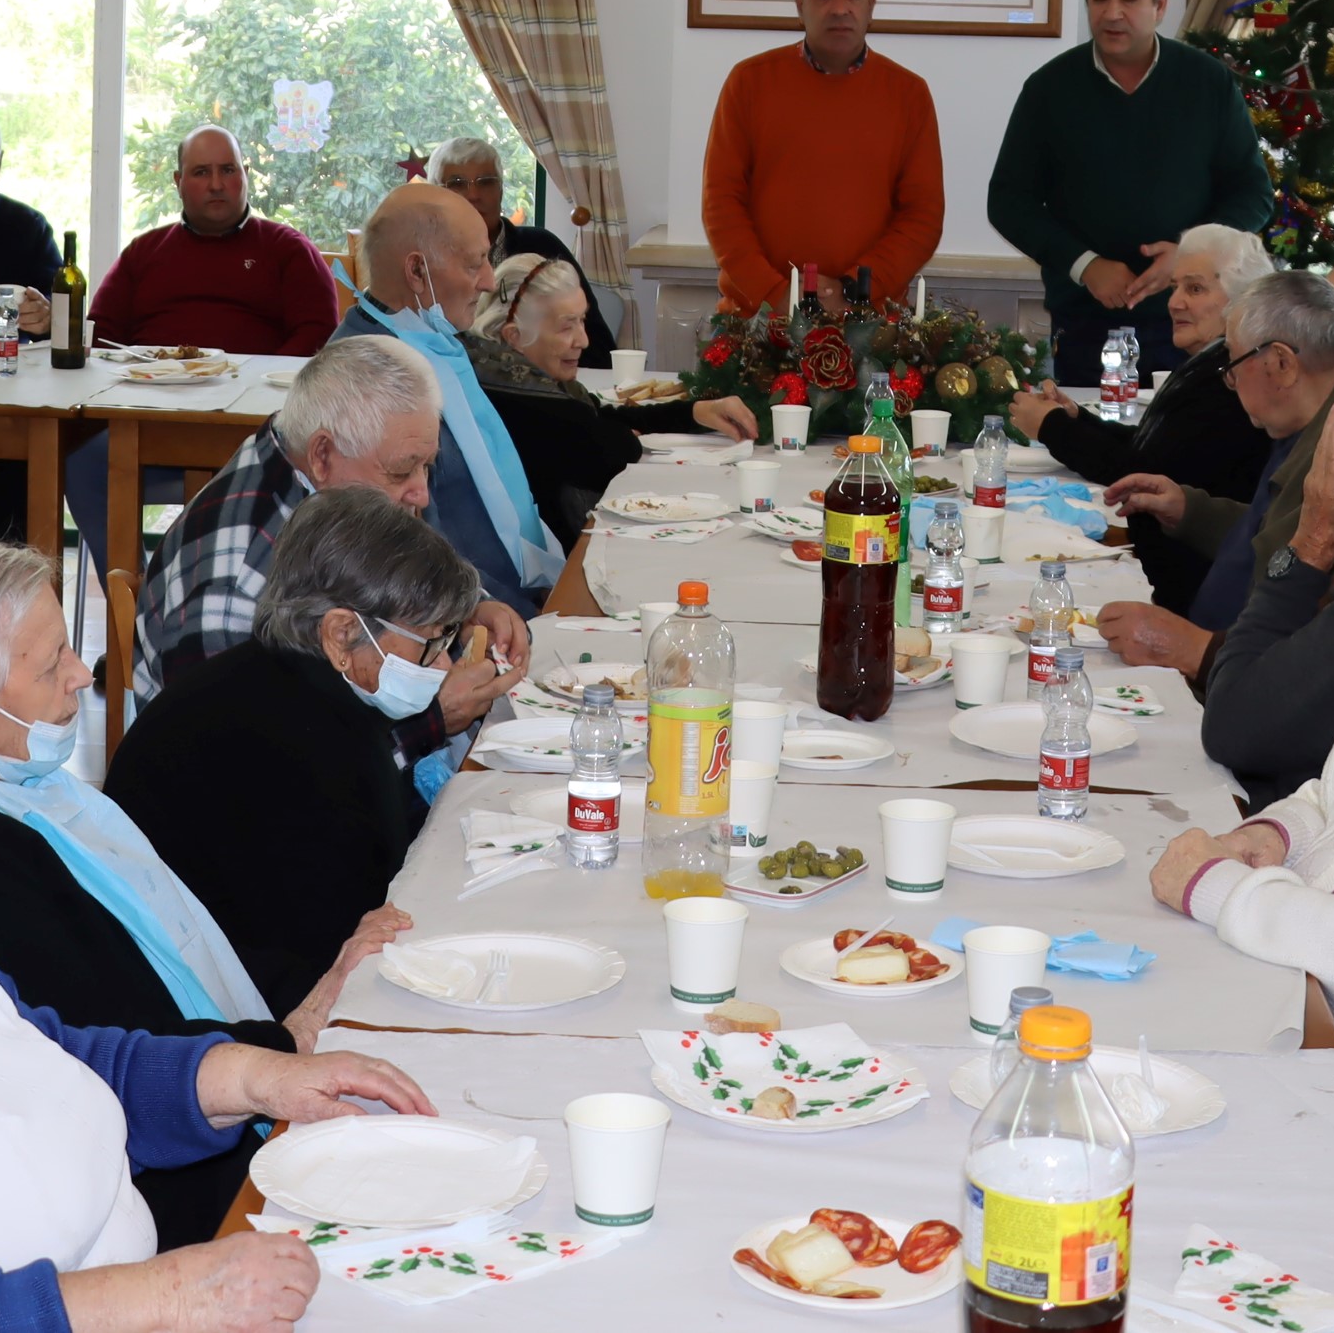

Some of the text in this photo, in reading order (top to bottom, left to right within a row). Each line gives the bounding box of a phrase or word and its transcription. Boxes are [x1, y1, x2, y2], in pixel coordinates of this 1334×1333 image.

[930, 594, 953, 604] DuVale
[1033, 662, 1055, 673] DuVal
[574, 807, 605, 820] DuVale
